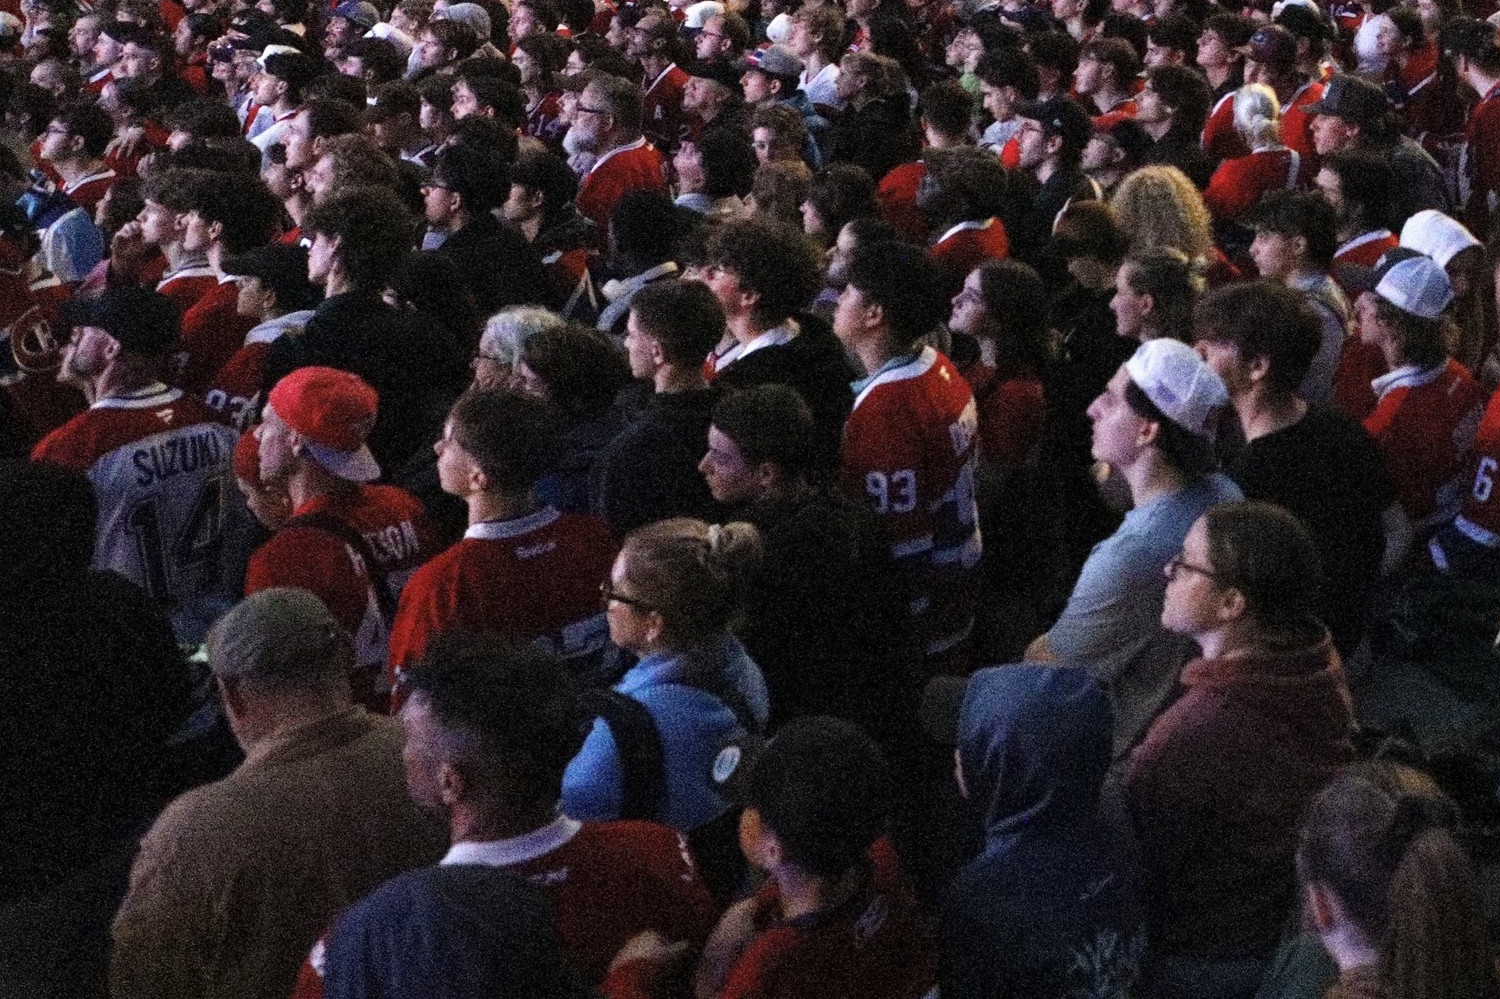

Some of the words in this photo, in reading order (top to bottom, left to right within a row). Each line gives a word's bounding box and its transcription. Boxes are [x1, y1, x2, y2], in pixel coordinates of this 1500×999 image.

[132, 430, 221, 487] SUZUKI
[1474, 455, 1499, 502] 6
[865, 468, 917, 515] 93
